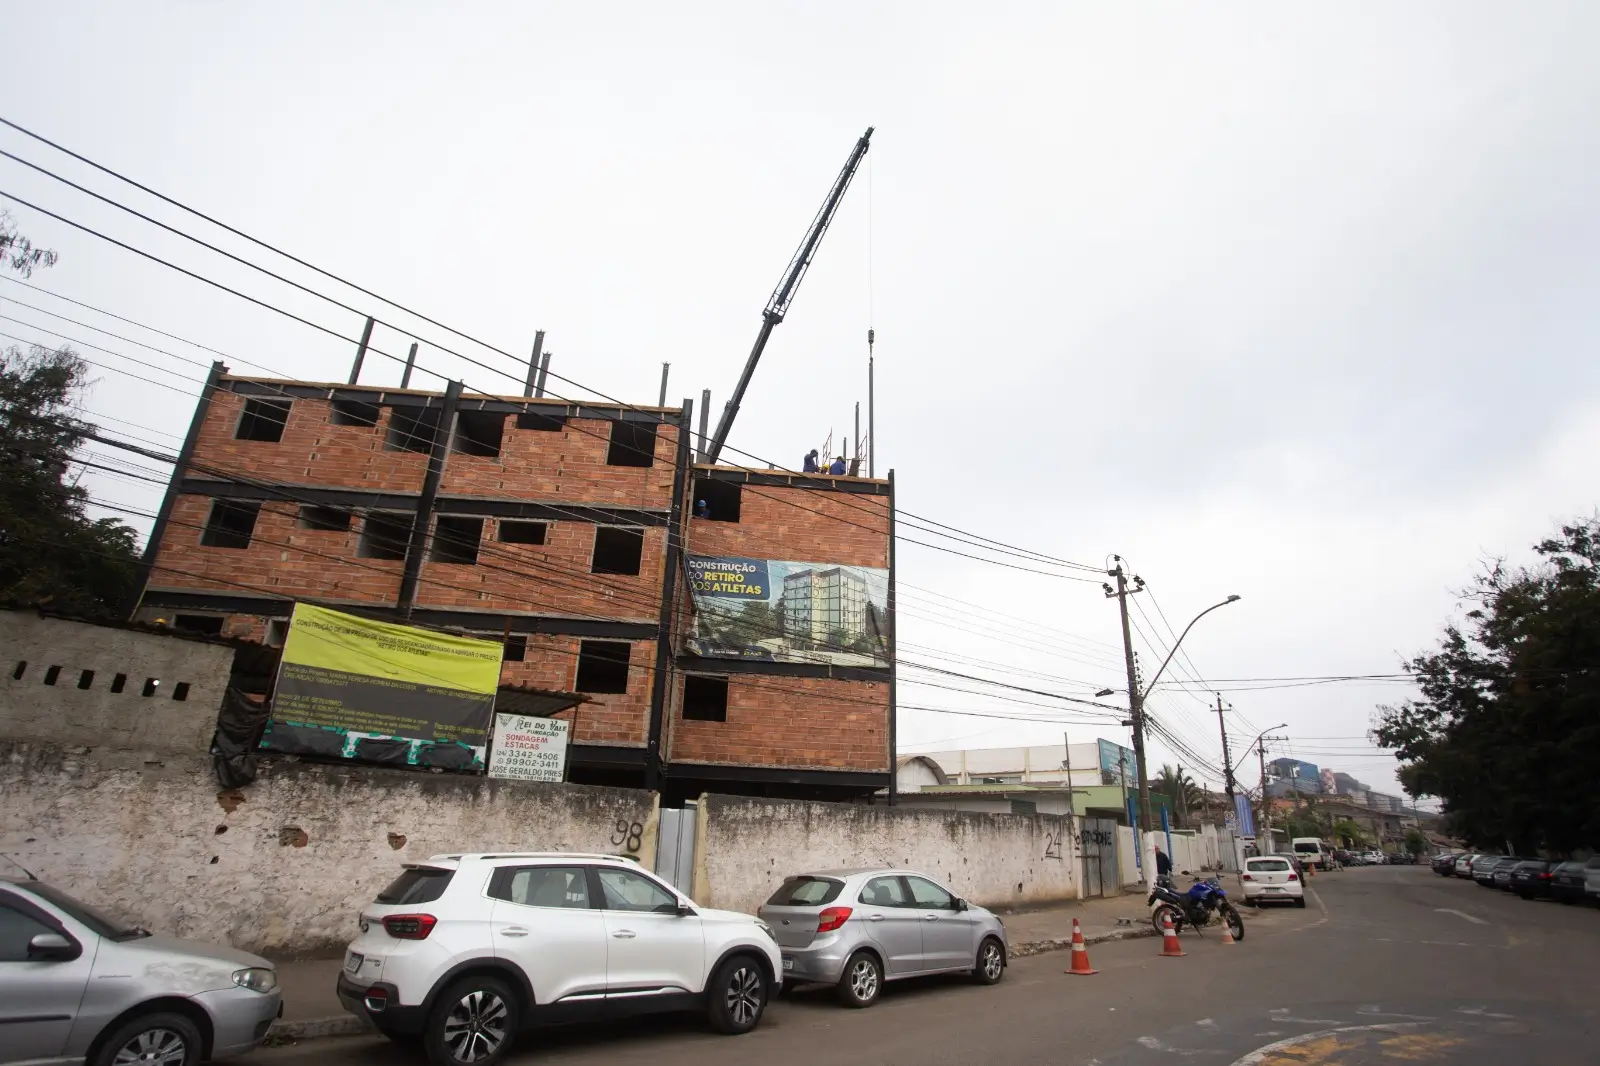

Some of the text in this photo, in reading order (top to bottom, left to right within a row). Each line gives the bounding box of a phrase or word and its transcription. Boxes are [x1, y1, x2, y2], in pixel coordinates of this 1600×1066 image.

[689, 561, 756, 574] CONSTRUÇÃO
[689, 572, 744, 582] DO RETIRO
[712, 582, 762, 594] ATLETAS
[296, 619, 332, 632] CONSTRUÇÃO
[480, 653, 498, 662] PROJETO
[534, 722, 546, 730] DO
[550, 720, 566, 732] VALE
[505, 734, 548, 744] SONDAGEM
[526, 730, 559, 738] FUNDAÇÃO
[504, 741, 540, 750] ESTACAS
[508, 750, 558, 760] 3342-4506
[506, 758, 558, 768] 99902-3411
[509, 766, 542, 776] GERALDO
[544, 769, 562, 778] PIRES
[610, 820, 643, 853] 98
[1046, 832, 1062, 862] 24
